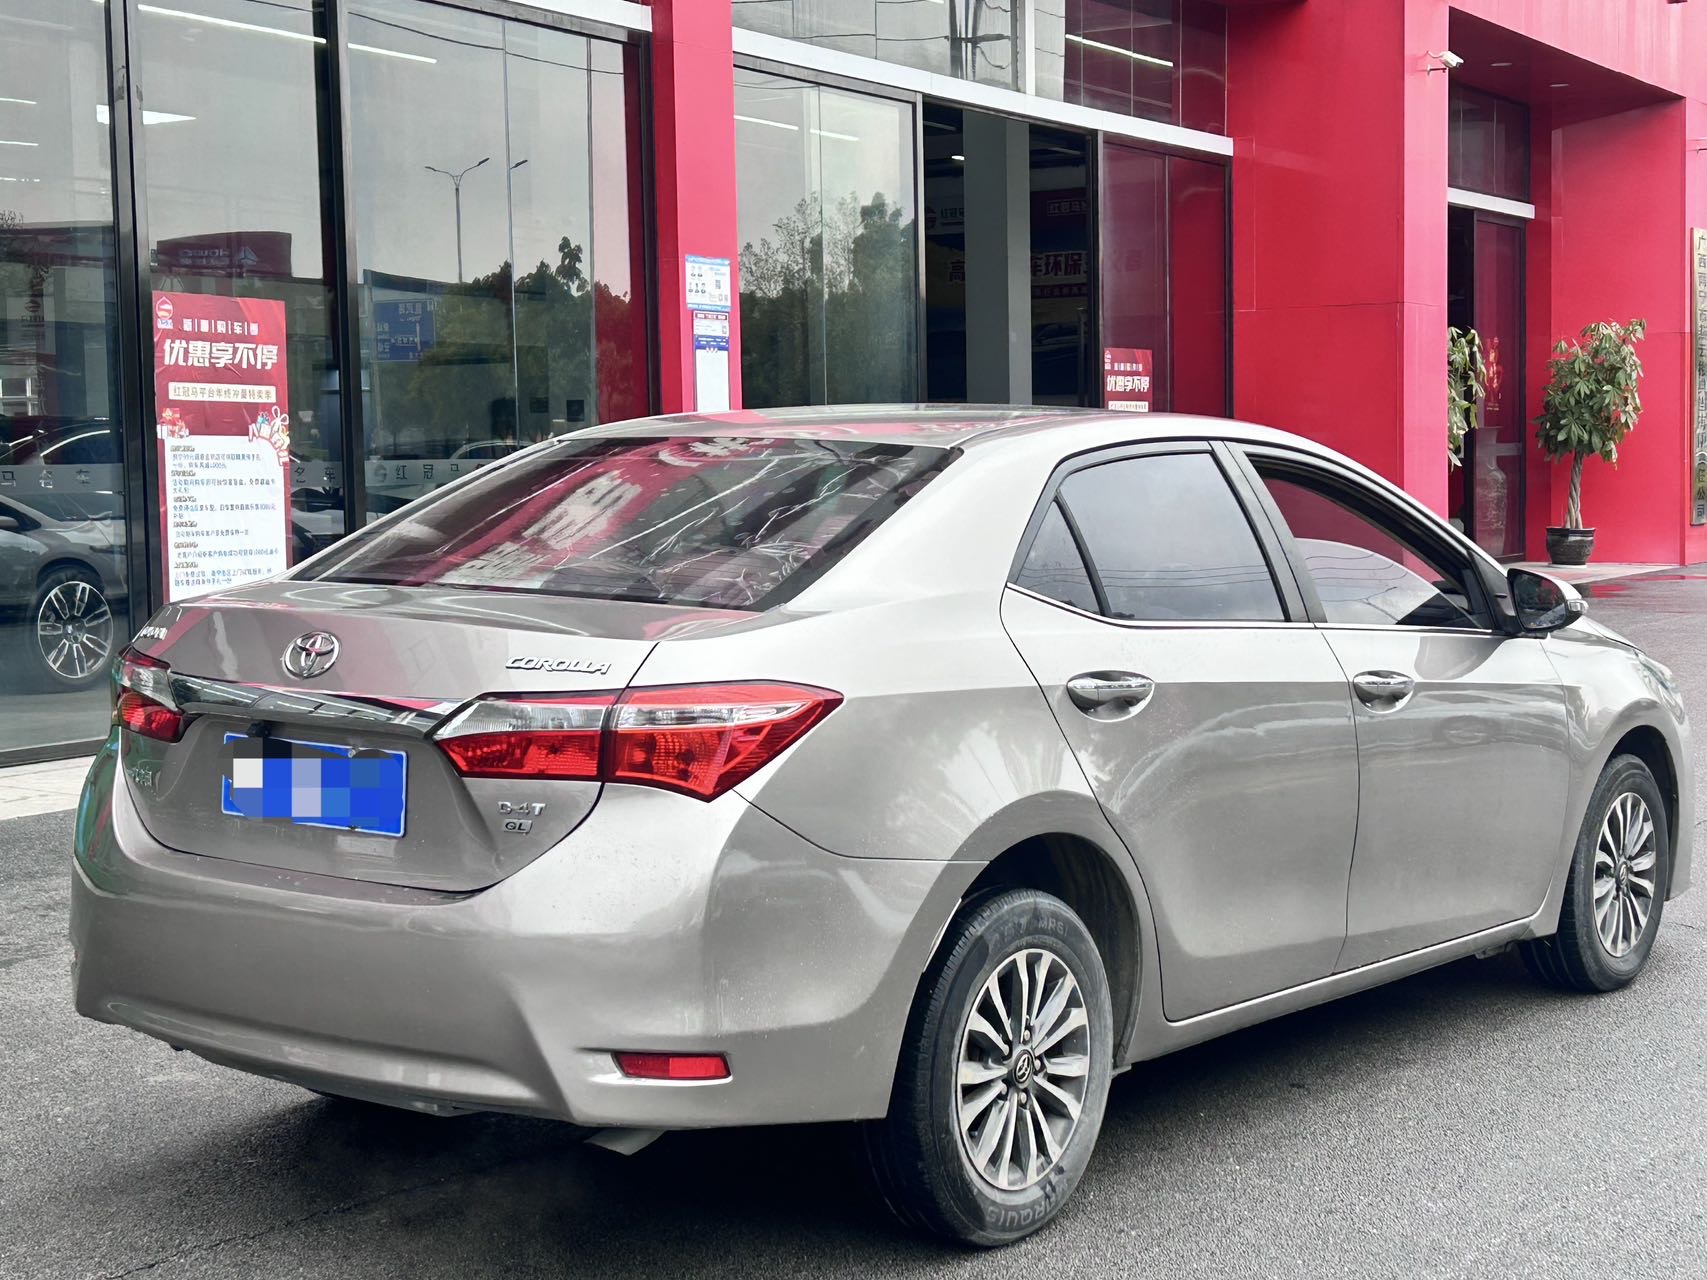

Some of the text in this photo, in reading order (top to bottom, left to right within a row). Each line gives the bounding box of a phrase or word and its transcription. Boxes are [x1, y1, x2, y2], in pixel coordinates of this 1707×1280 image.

[163, 338, 279, 370] 优惠享不停
[505, 657, 612, 675] COROLLA
[504, 821, 528, 831] GL
